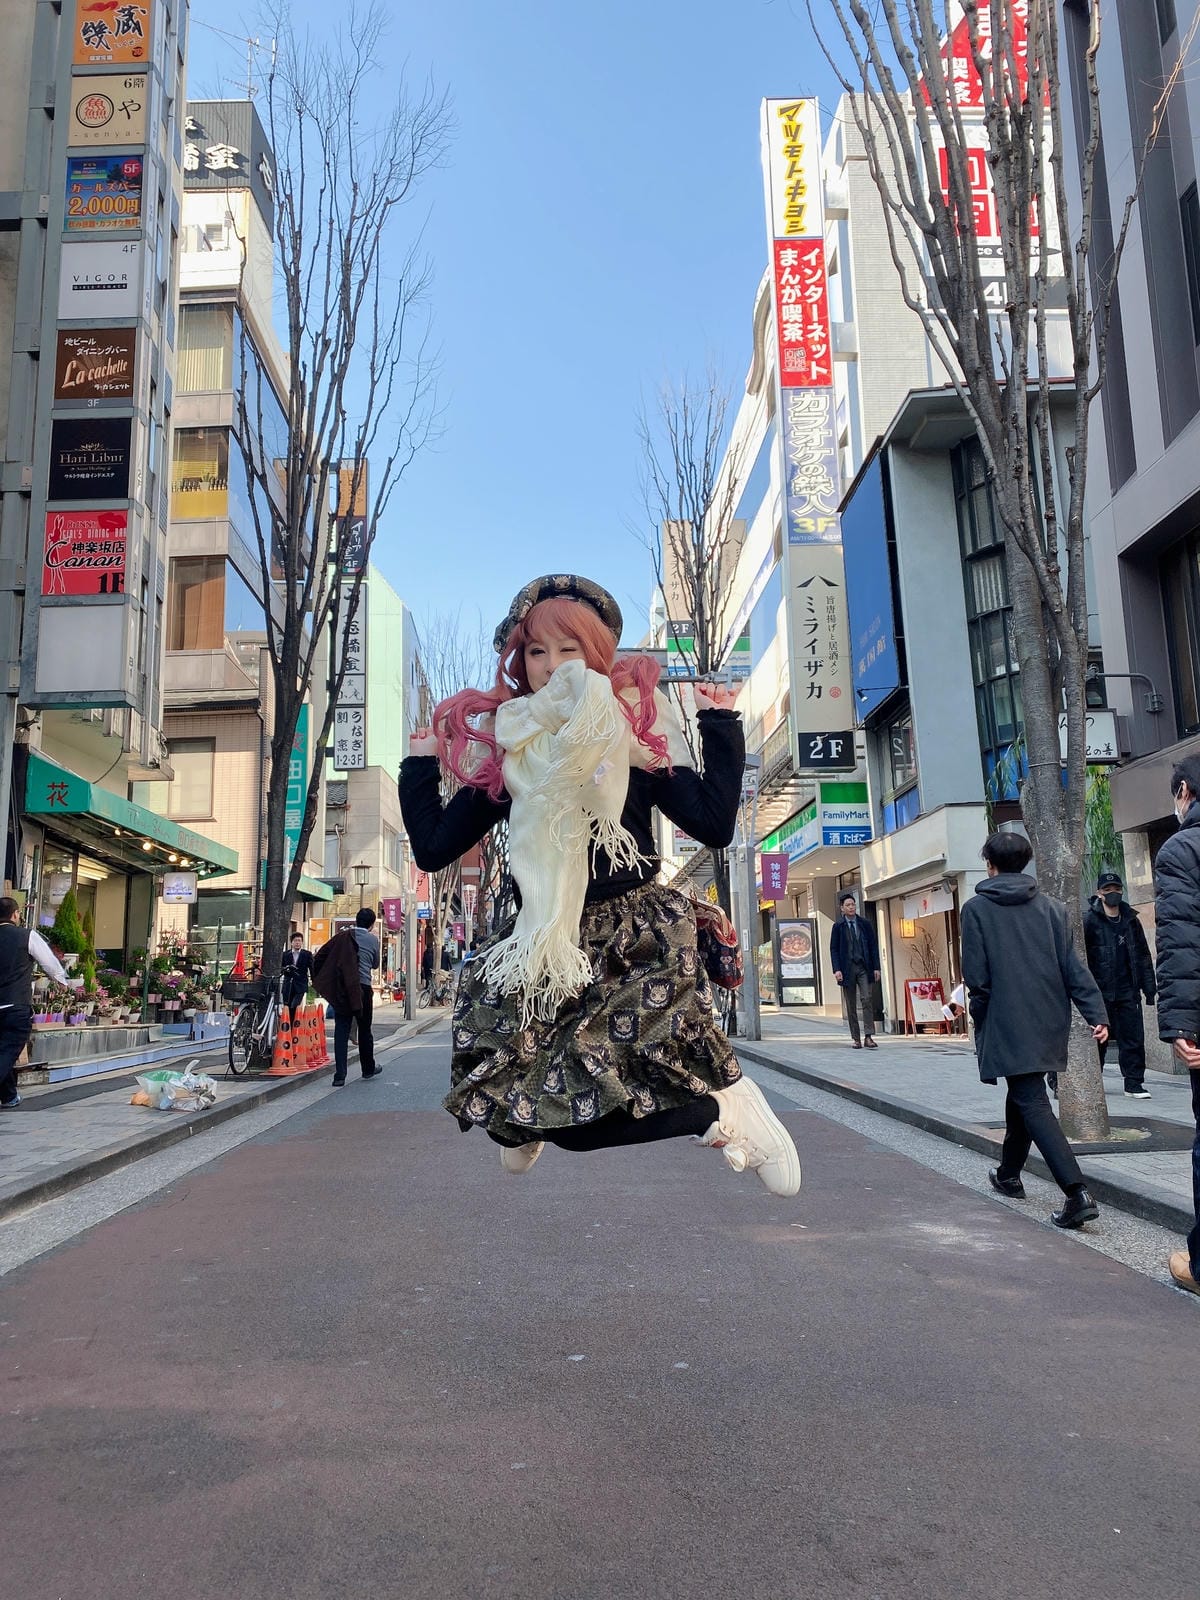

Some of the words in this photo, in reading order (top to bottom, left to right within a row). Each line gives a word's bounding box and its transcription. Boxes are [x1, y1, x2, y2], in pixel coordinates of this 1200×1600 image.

[124, 163, 140, 173] 5F
[779, 101, 806, 234] マツモトキヨシ
[69, 195, 139, 216] 2,000円
[122, 245, 137, 253] 4F
[73, 274, 127, 282] VIGOR
[780, 249, 804, 342] まんが喫茶
[801, 247, 828, 380] インターネット
[64, 338, 96, 346] 地ビール
[76, 346, 128, 356] ダイニングバー
[61, 360, 86, 388] La
[87, 357, 128, 381] cachette
[87, 399, 99, 407] 3F
[60, 453, 87, 463] Hari
[91, 452, 124, 462] Libur
[789, 391, 834, 517] カラオケの鉄人
[793, 517, 837, 534] 3F
[72, 541, 124, 554] 神楽坂店
[803, 596, 824, 700] ミライザカ
[351, 711, 363, 752] うなぎ
[47, 782, 69, 807] 花
[823, 810, 869, 821] FamilyMart
[829, 833, 841, 845] 酒
[844, 833, 865, 844] たばこ
[770, 862, 781, 889] 神楽坂
